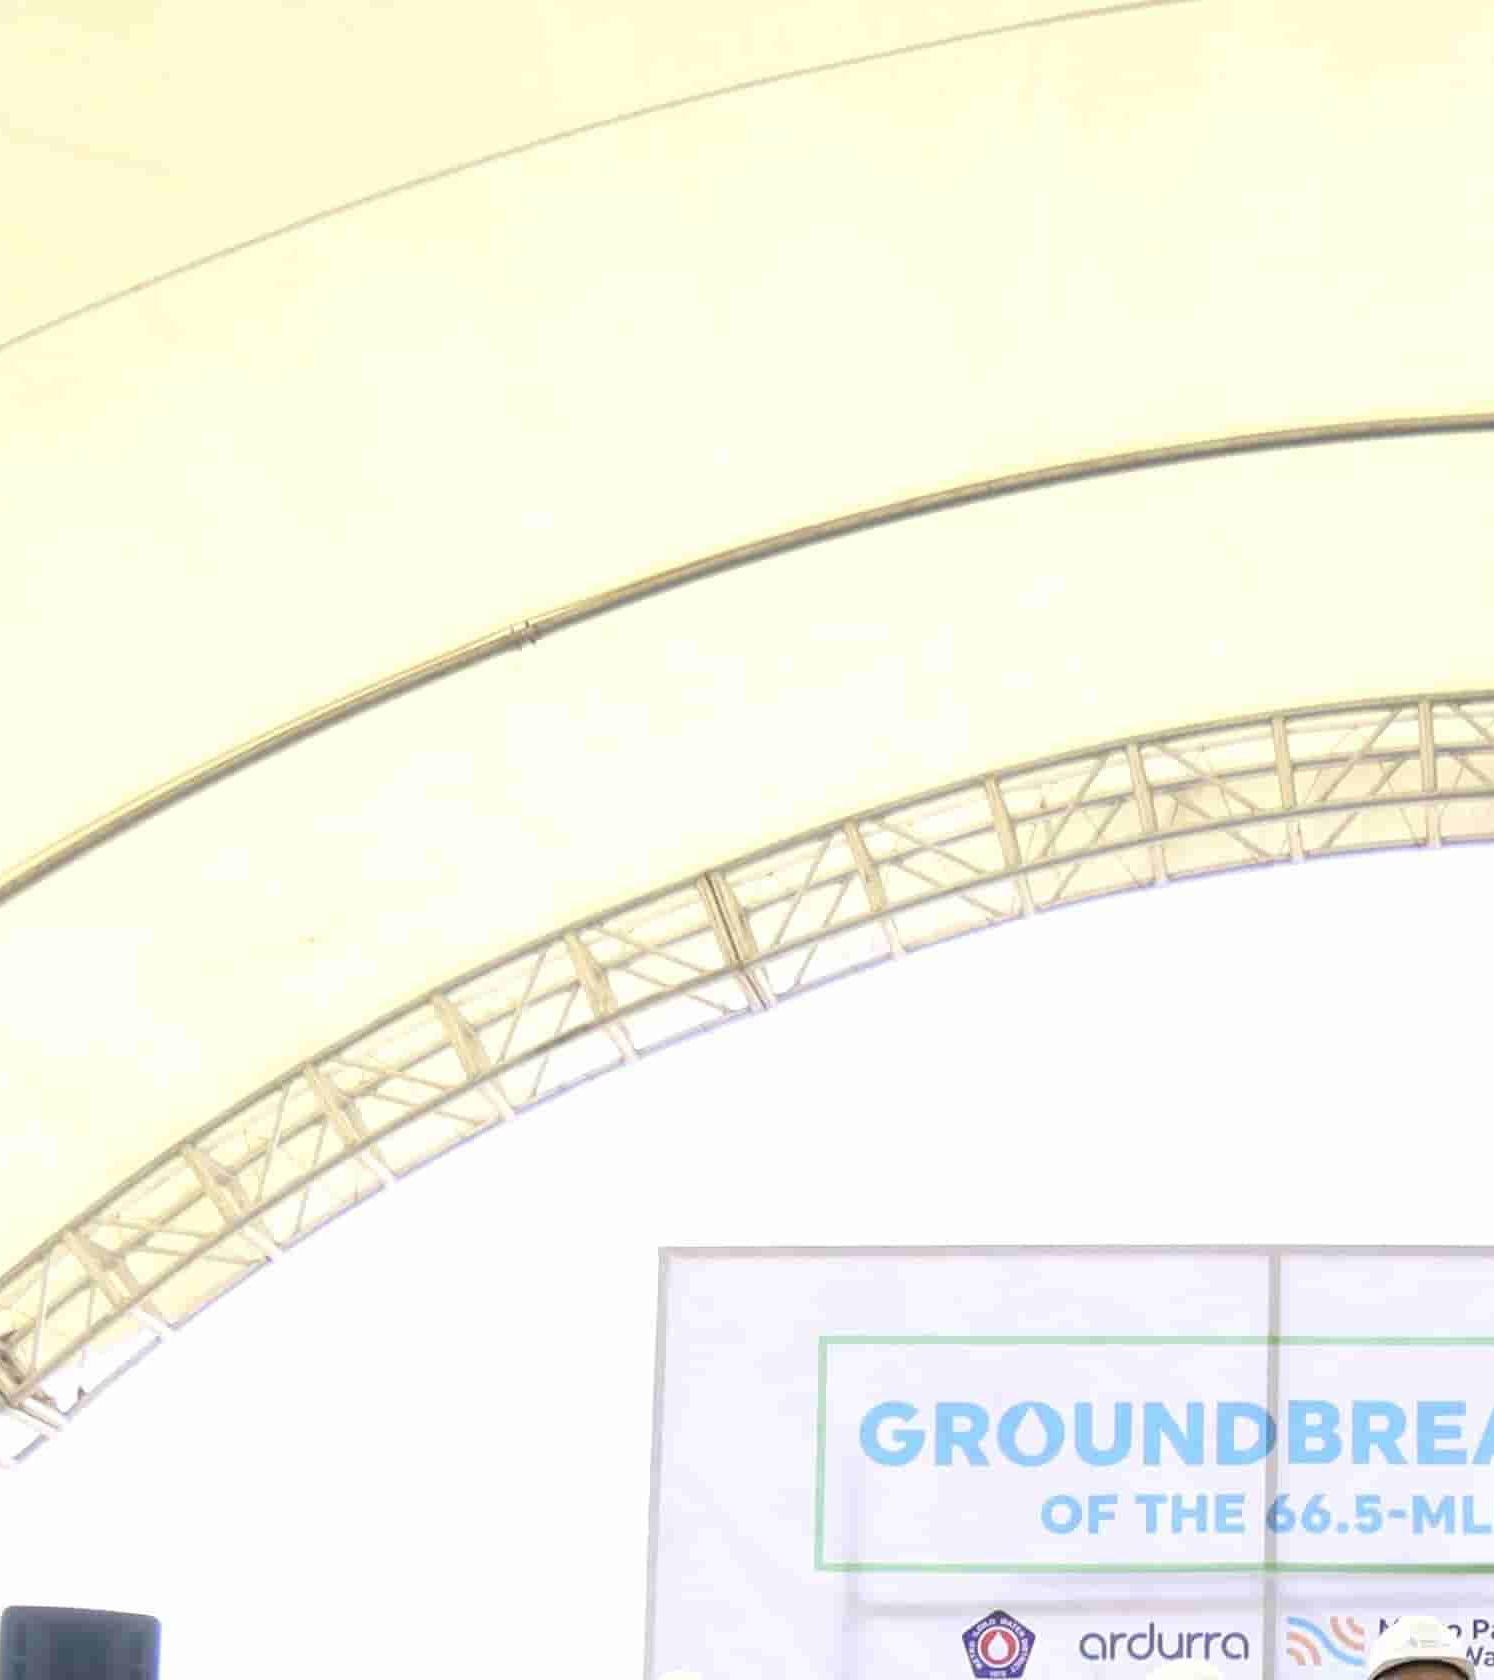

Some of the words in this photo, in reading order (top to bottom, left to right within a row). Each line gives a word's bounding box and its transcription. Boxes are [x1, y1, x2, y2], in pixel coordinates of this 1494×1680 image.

[1040, 1493, 1118, 1536] OF
[1134, 1493, 1246, 1535] THE
[1078, 1621, 1250, 1661] ardurra
